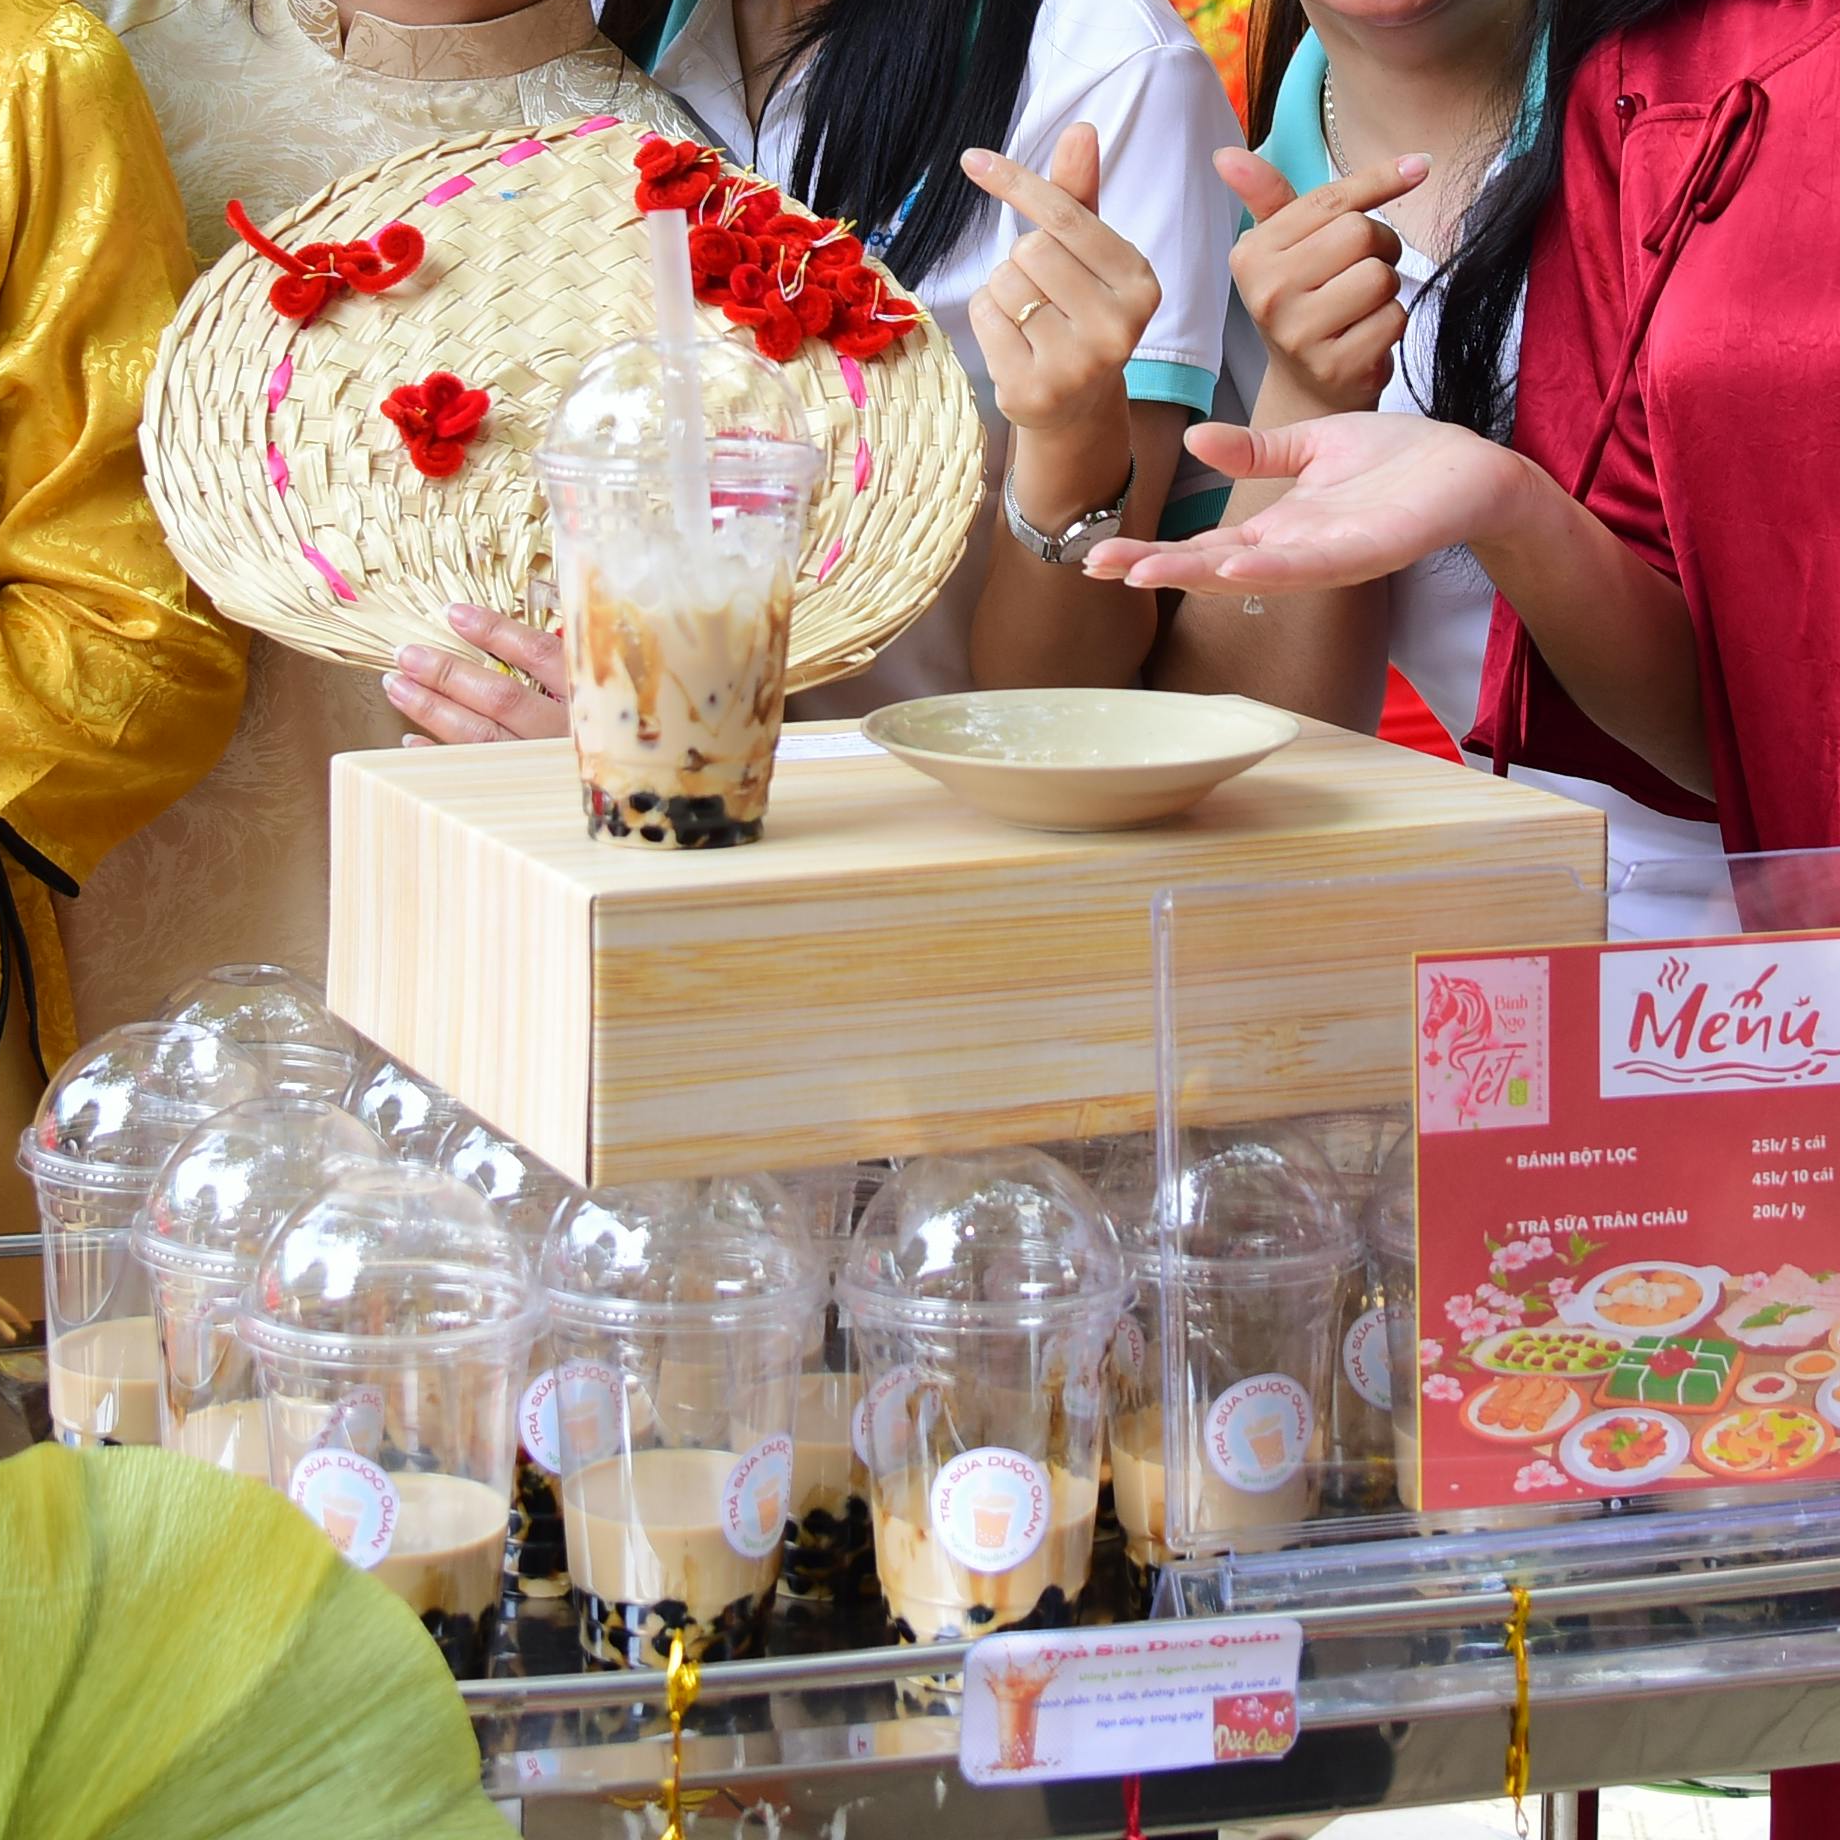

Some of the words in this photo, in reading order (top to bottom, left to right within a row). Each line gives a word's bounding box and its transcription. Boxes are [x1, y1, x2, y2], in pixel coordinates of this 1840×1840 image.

[1791, 1136, 1801, 1151] 5
[1517, 1151, 1565, 1170] BÁNH
[1569, 1146, 1603, 1168] BỘT
[1606, 1147, 1637, 1166] LỌC
[1791, 1168, 1809, 1183] 10
[1791, 1202, 1806, 1220] ly
[1518, 1216, 1550, 1235] TRÀ
[1554, 1213, 1589, 1234] SỮA
[1592, 1210, 1638, 1230] TRÂN
[1642, 1207, 1689, 1226] CHÂU
